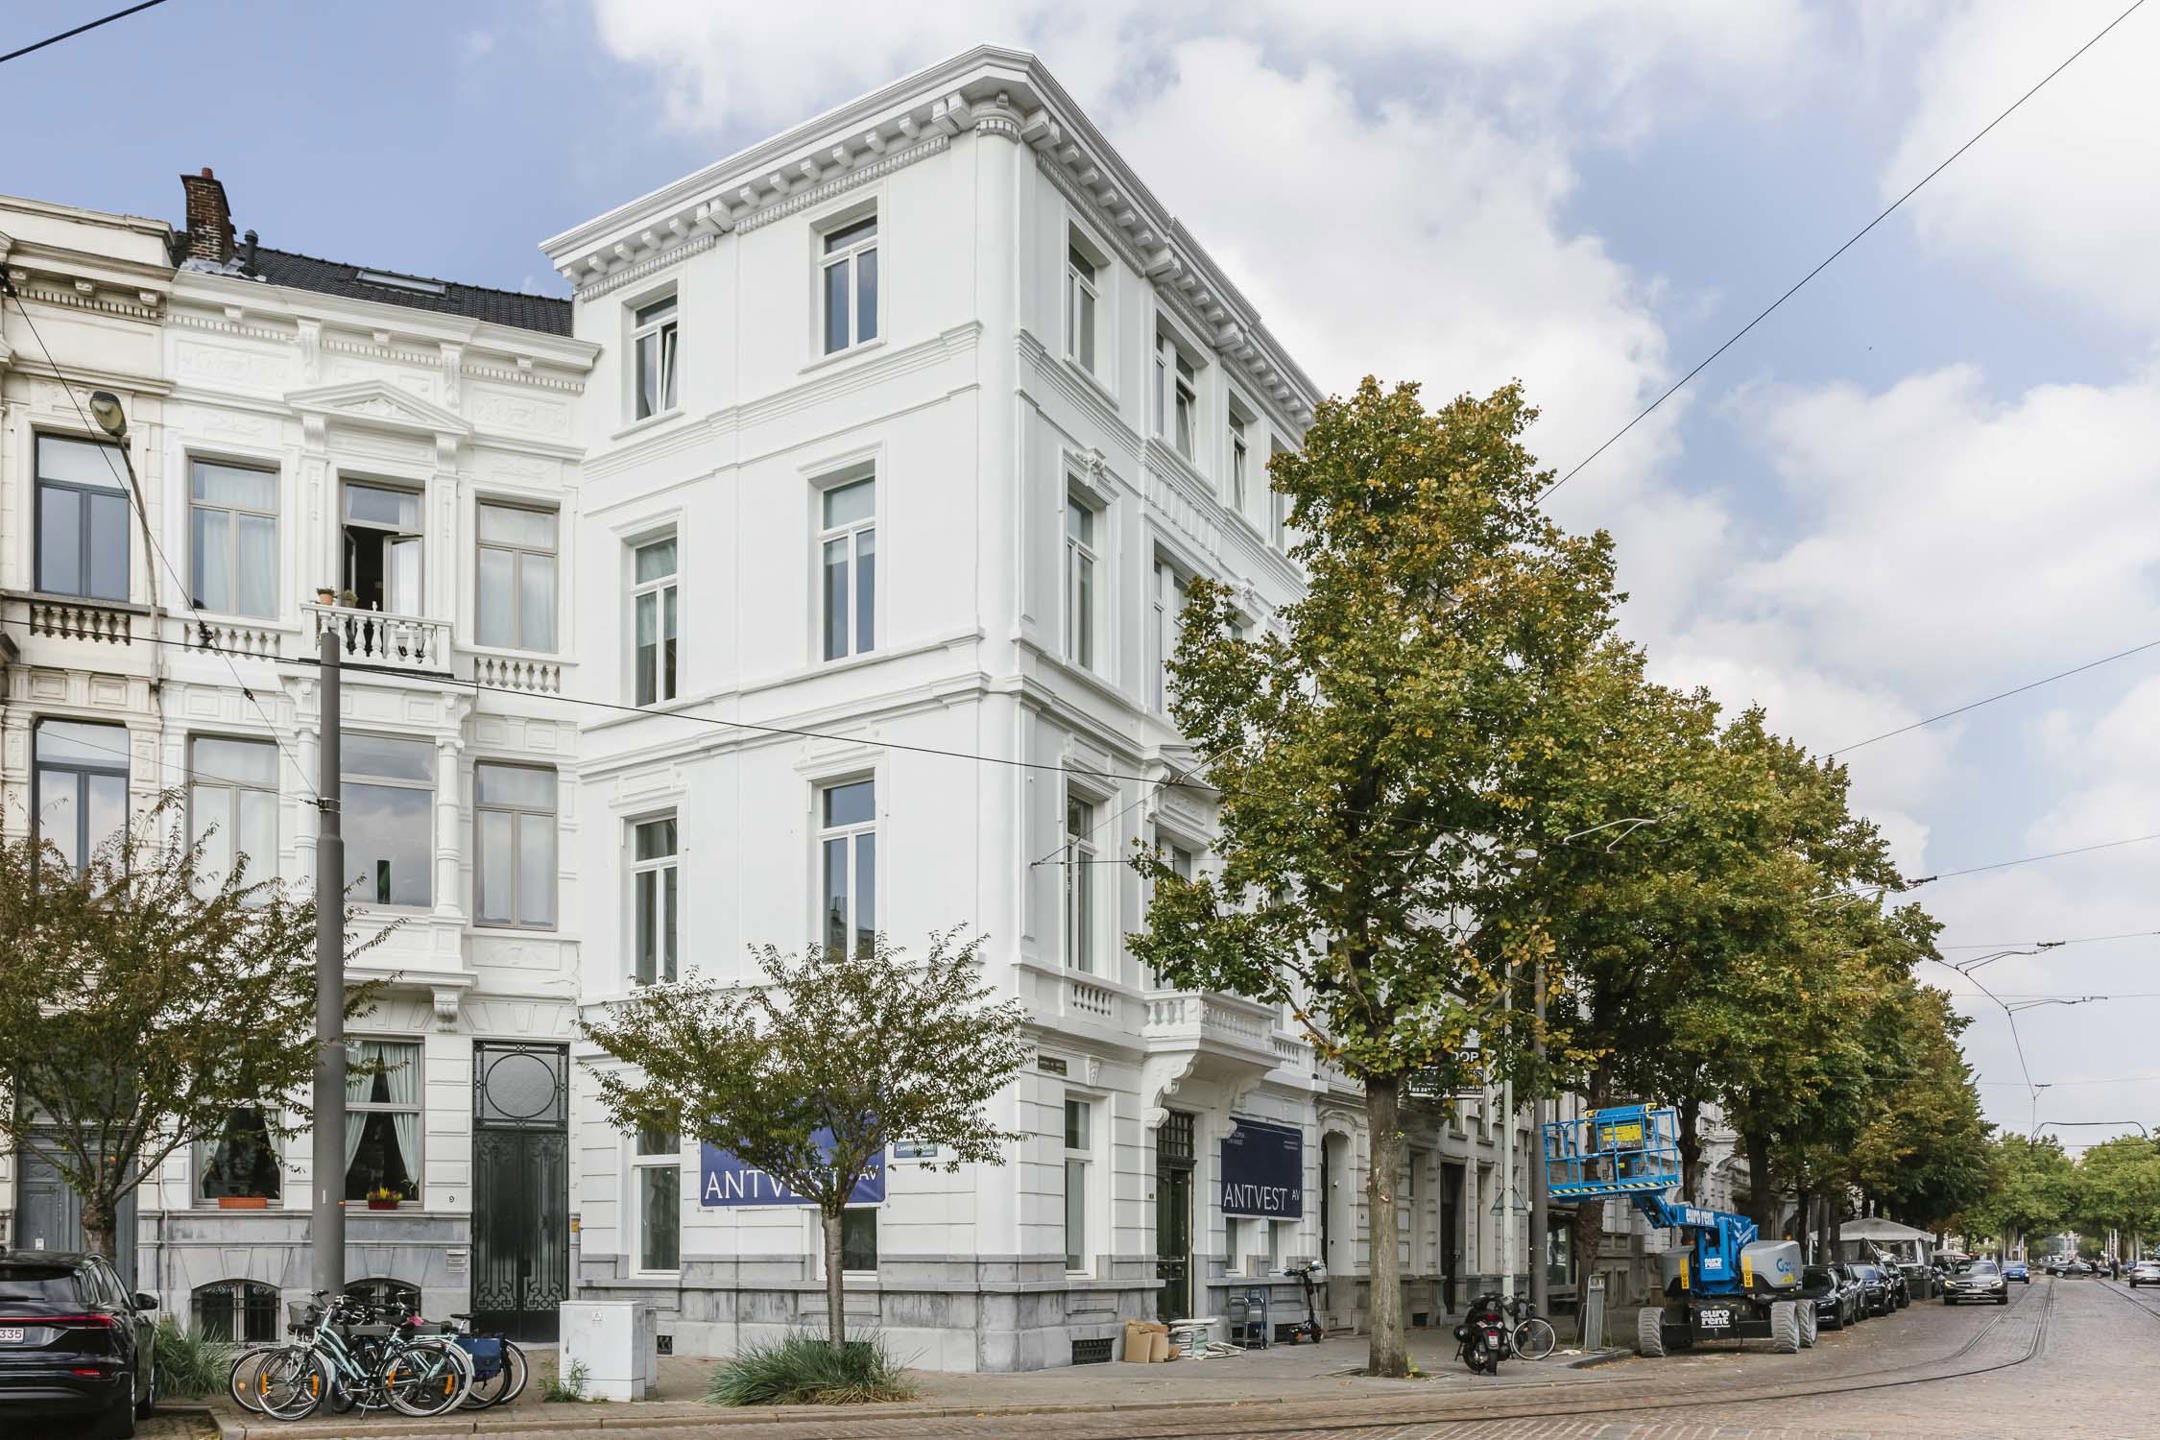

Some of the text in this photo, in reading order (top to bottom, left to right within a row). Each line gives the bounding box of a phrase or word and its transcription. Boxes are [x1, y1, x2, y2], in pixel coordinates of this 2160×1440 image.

[705, 1167, 839, 1199] ANTVEST
[1223, 1182, 1300, 1211] ANTVEST AV
[1686, 1207, 1715, 1226] euro rent
[1701, 1310, 1730, 1318] euro
[1701, 1317, 1729, 1325] rent
